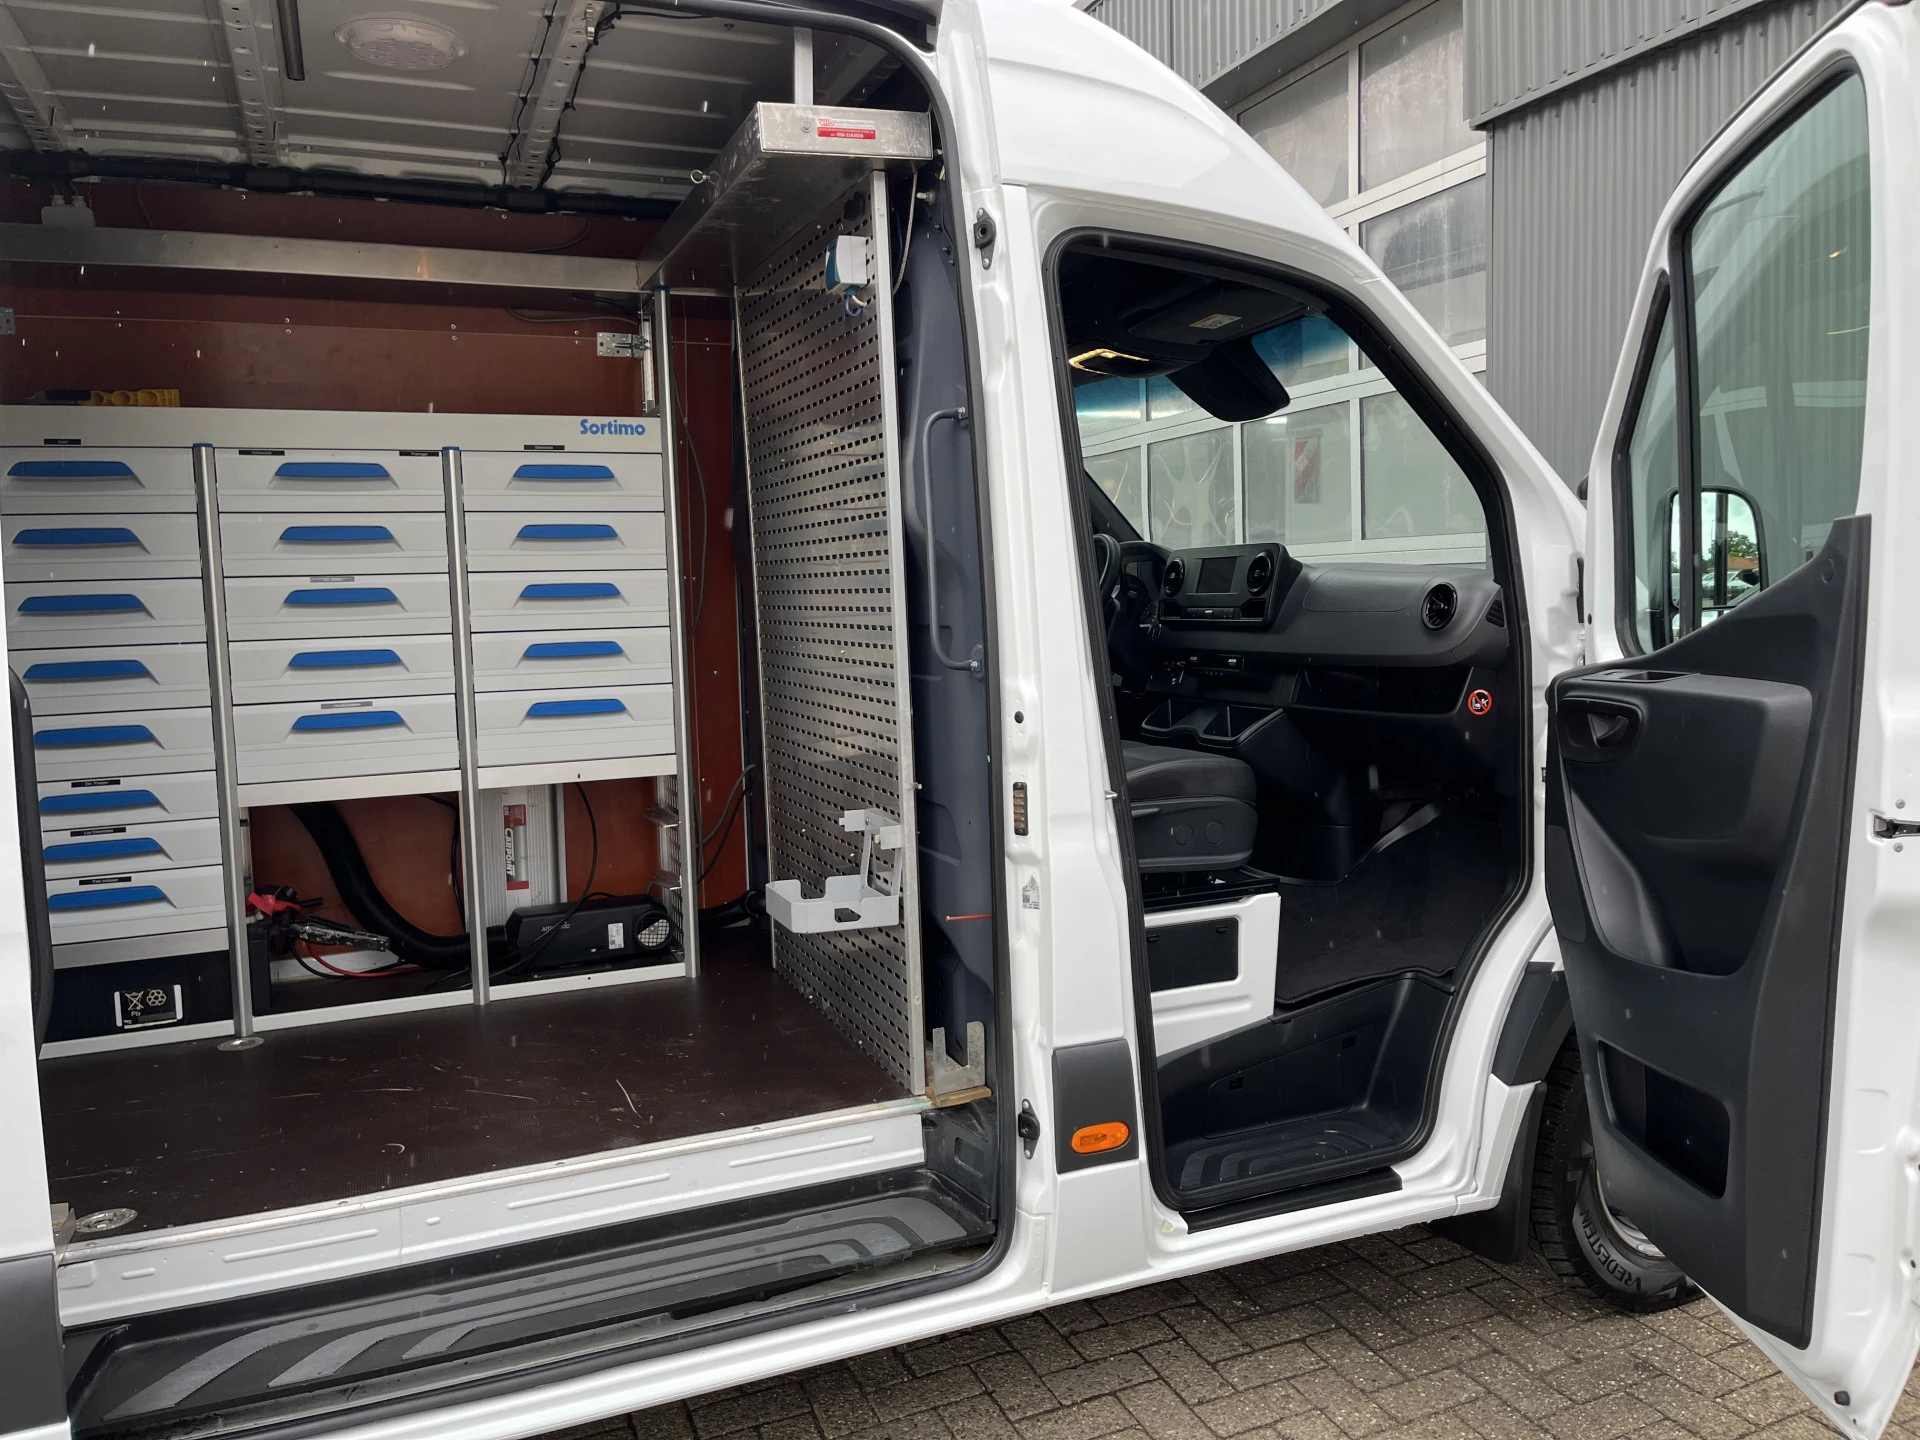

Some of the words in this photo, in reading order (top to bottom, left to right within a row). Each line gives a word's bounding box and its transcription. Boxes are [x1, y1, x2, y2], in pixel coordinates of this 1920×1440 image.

[580, 419, 646, 436] Sortimo
[505, 828, 516, 877] CARPOINT
[1579, 1208, 1643, 1292] VREDESTEIN
